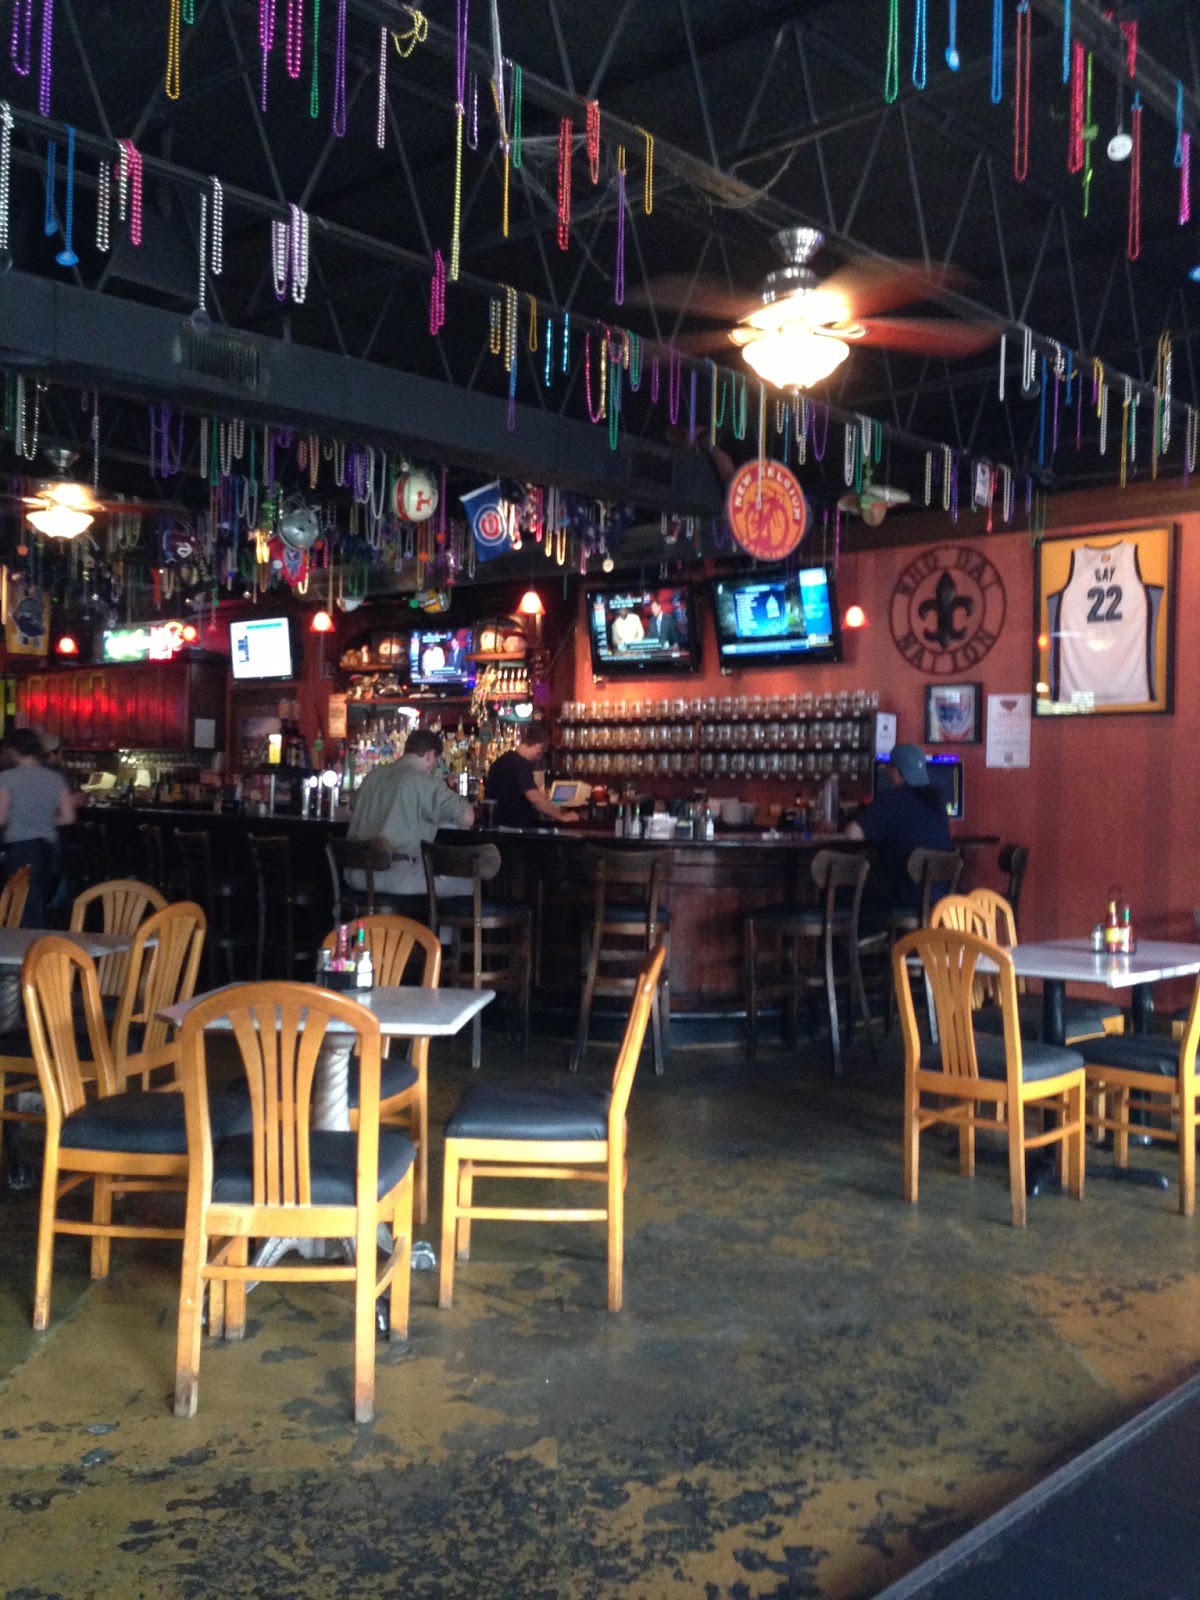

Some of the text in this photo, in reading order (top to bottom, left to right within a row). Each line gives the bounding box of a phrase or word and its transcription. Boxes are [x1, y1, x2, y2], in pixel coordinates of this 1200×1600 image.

[734, 473, 751, 507] NEW
[1094, 565, 1117, 583] GAY
[1087, 585, 1123, 623] 22
[896, 629, 996, 674] NATION
